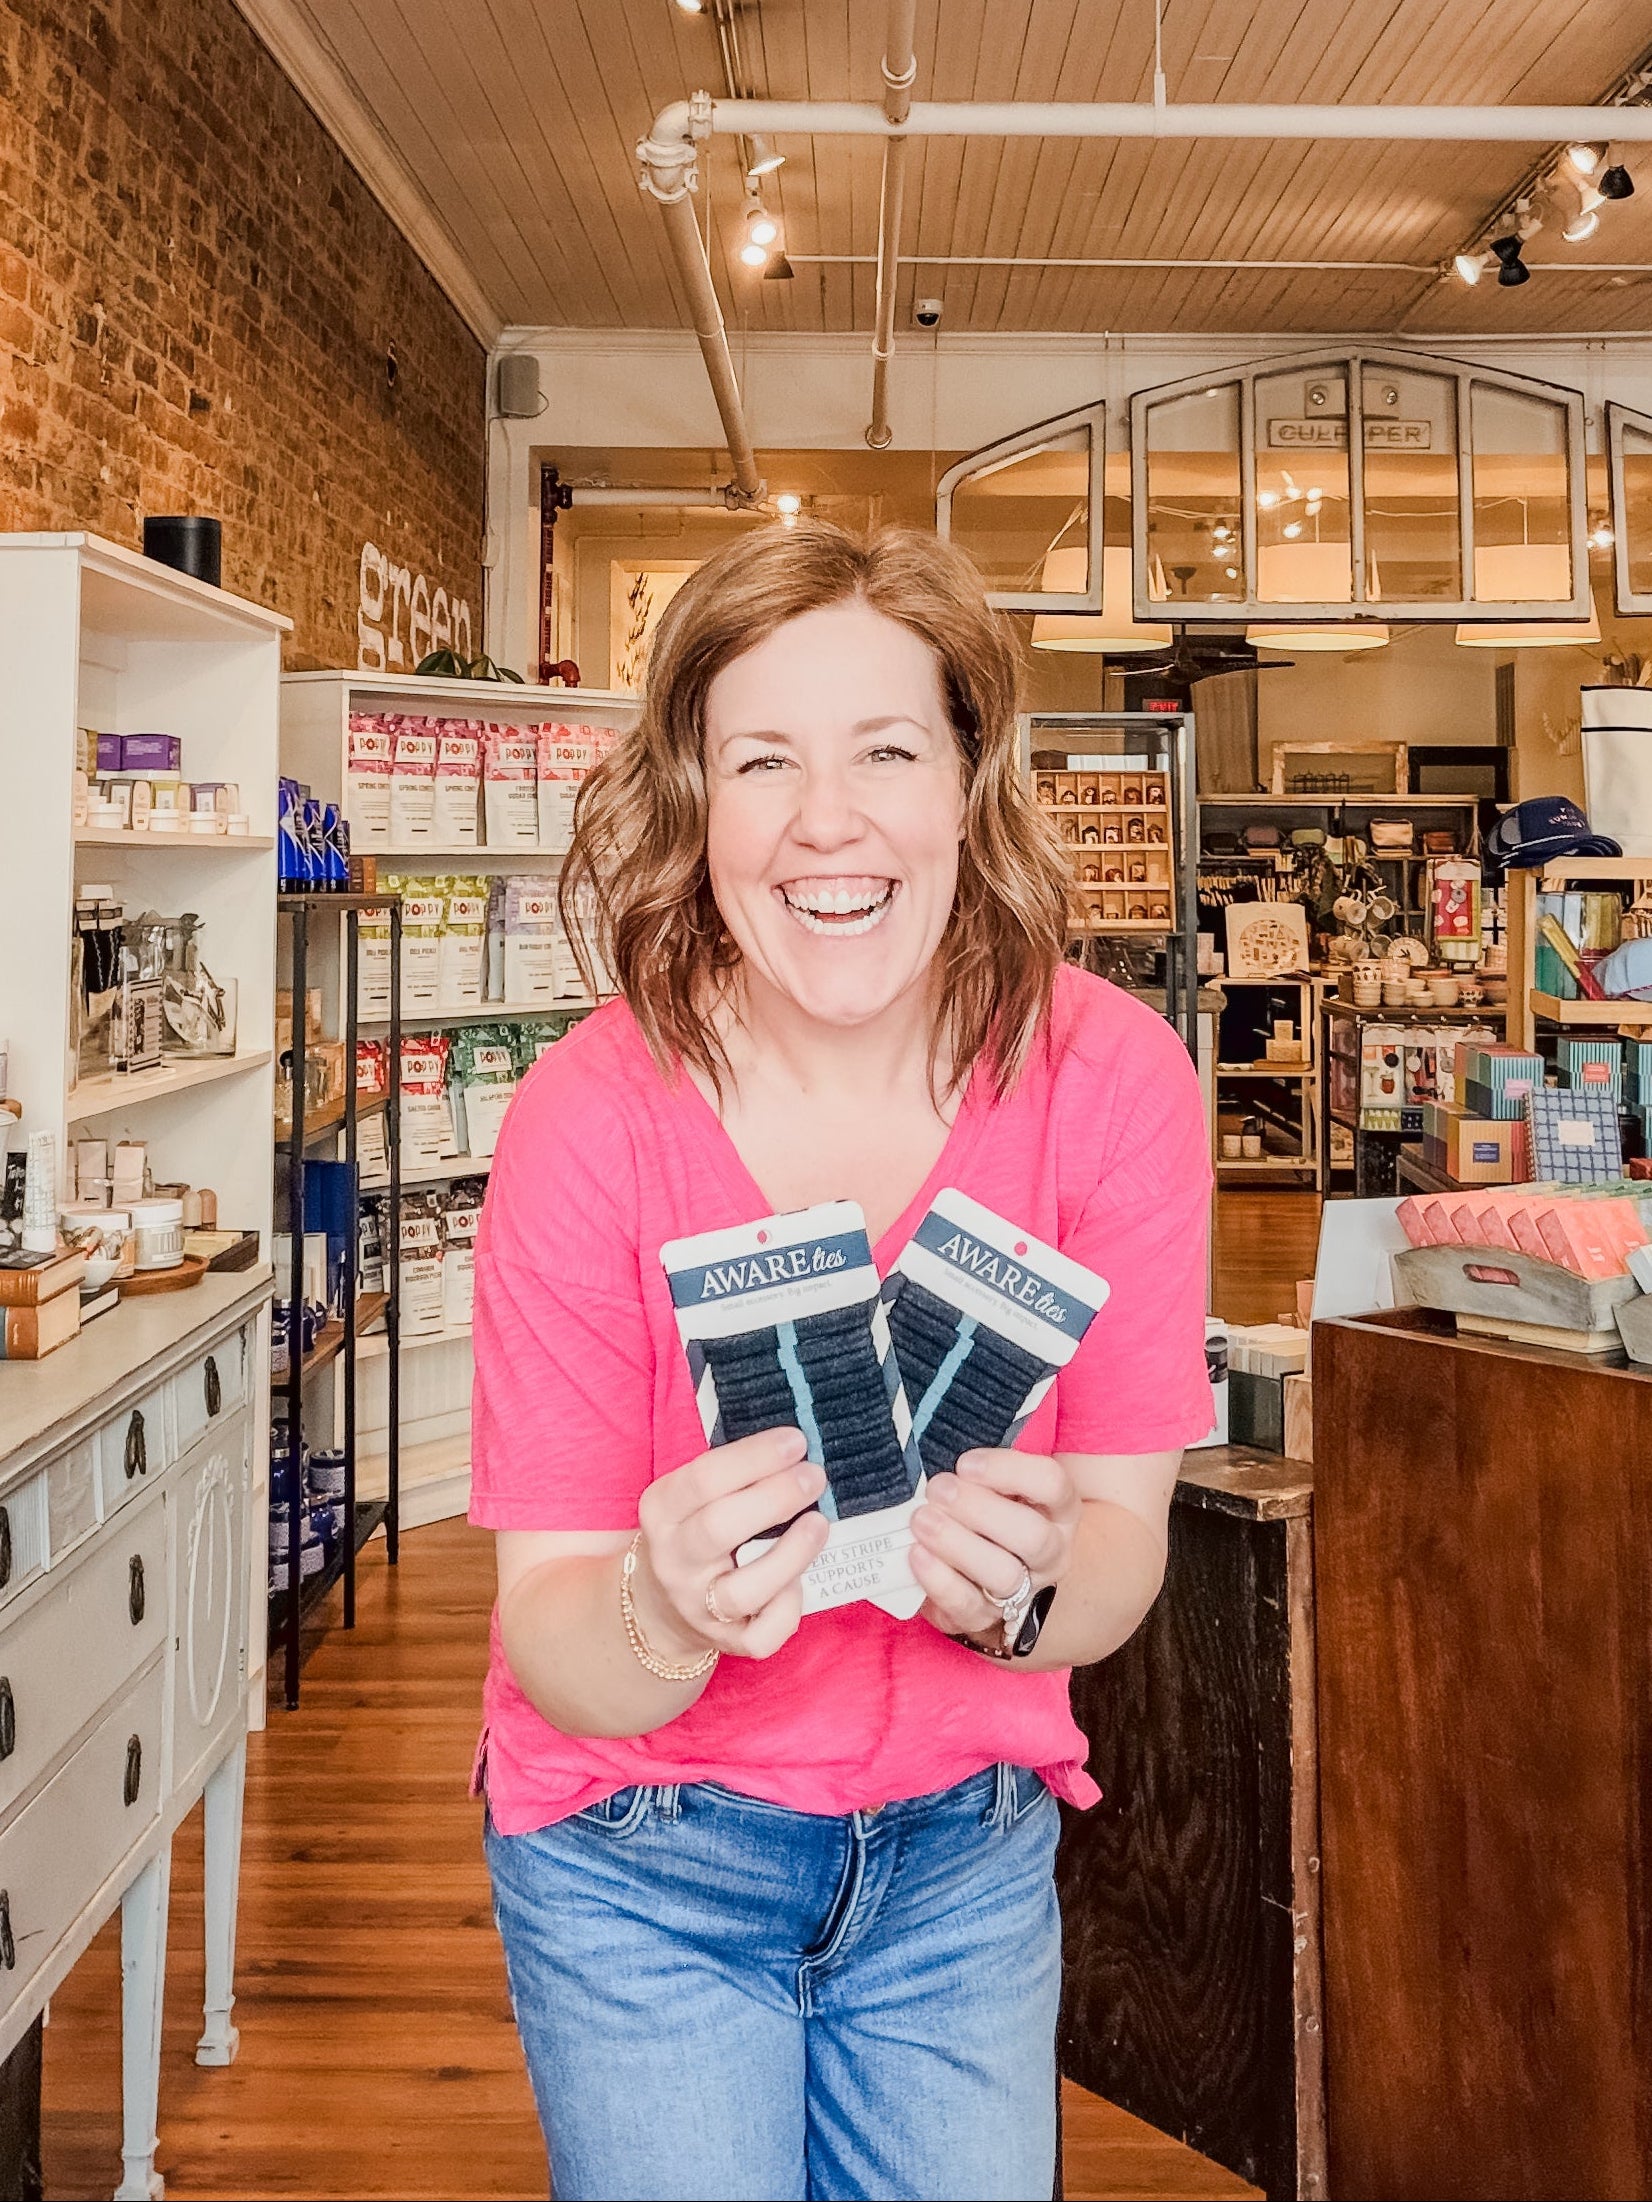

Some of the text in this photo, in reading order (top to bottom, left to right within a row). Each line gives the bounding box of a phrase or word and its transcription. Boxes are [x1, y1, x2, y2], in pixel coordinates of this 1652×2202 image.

[1278, 424, 1421, 443] CULPPER
[358, 541, 472, 672] green
[400, 740, 433, 753] POPPY
[556, 748, 587, 760] POPPY
[404, 903, 439, 916] POPPY
[407, 1060, 439, 1074] POPPY
[402, 1223, 432, 1239] POPPY
[700, 1246, 847, 1299] AWARE ties
[937, 1233, 1067, 1322] AWARE ties
[812, 1537, 893, 1568] ERY STRIPE
[808, 1558, 885, 1586] SUPPORTS
[820, 1573, 881, 1598] A CAUSE
